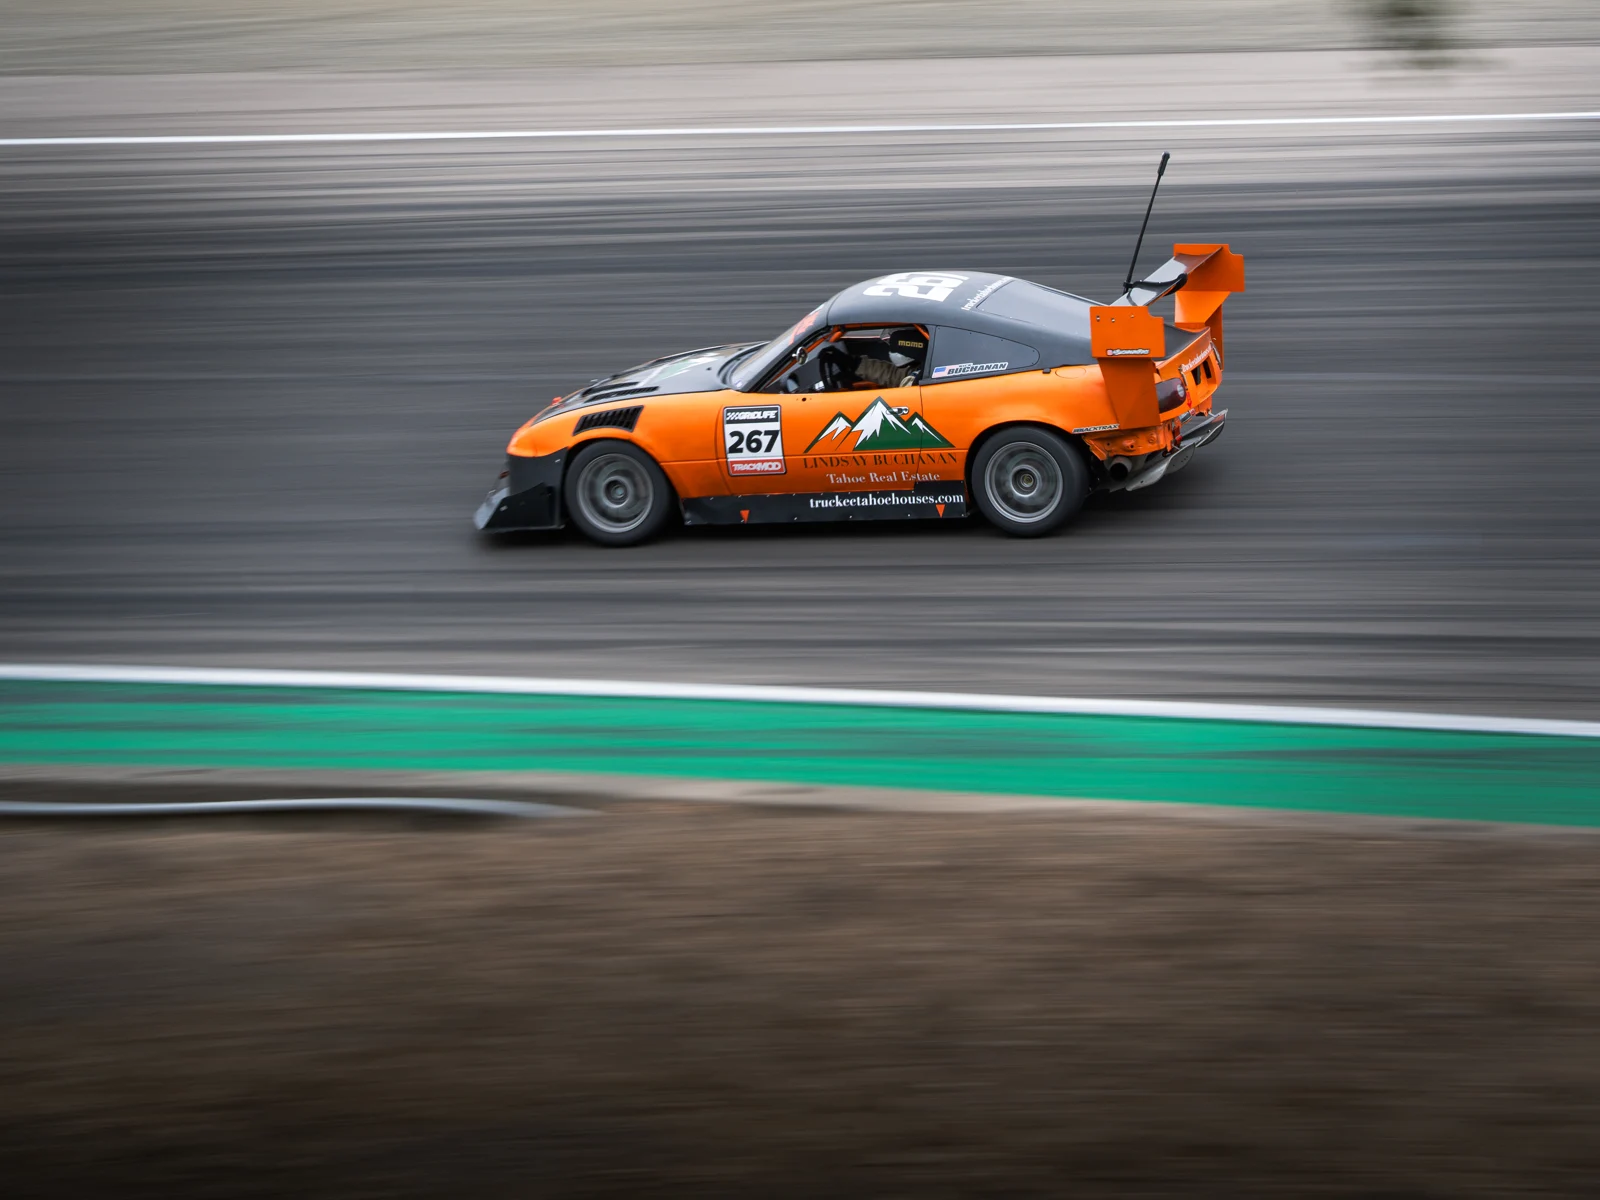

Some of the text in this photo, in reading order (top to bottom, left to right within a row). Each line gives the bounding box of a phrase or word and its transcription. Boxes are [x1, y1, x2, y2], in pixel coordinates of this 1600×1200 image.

[947, 363, 1007, 375] BUCHANAN
[728, 430, 780, 453] 267
[731, 461, 781, 472] TRACKMOD
[803, 453, 957, 469] LINDSAY BUCHANAN
[826, 471, 940, 484] Tahoe Real Estate
[809, 493, 964, 508] truckeetahoehouses.com
